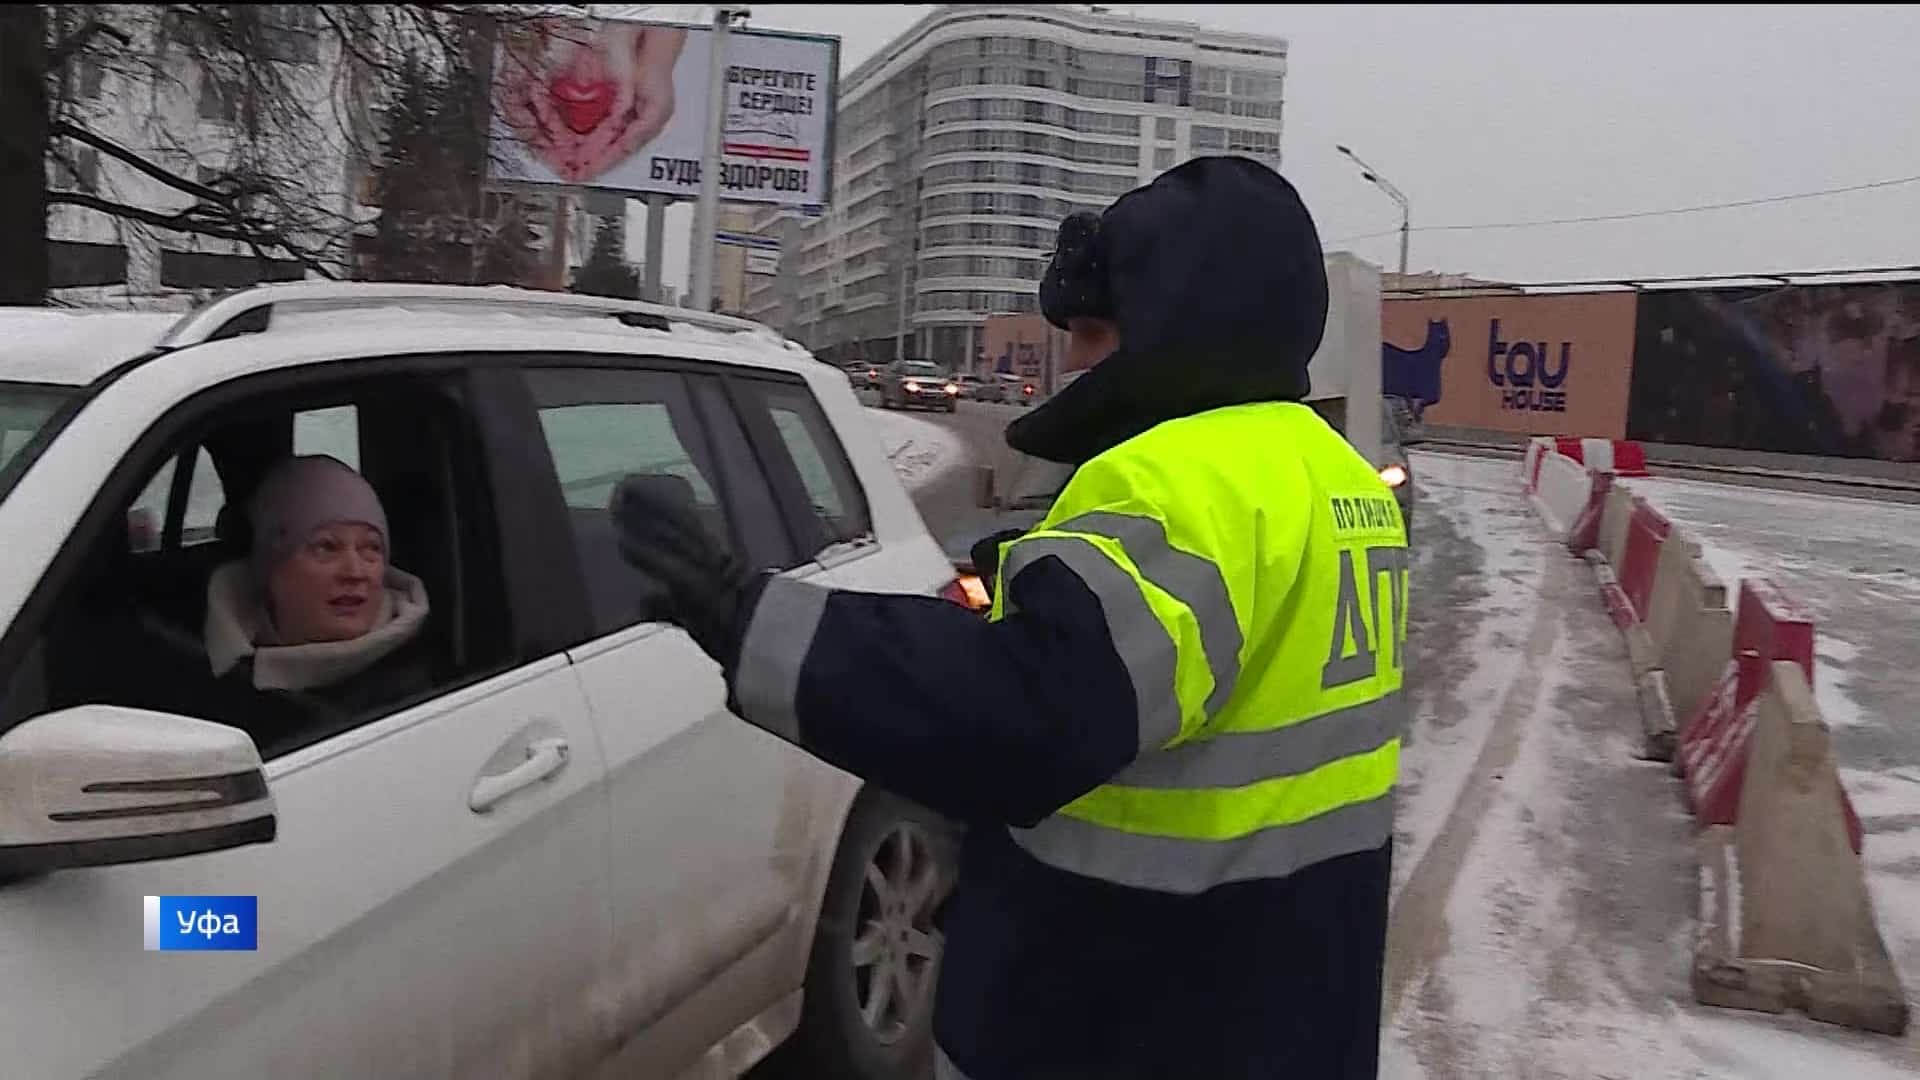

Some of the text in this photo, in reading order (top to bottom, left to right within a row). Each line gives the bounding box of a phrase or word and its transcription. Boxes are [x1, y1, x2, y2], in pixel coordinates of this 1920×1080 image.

[727, 65, 816, 91] БЕРЕГИТЕ
[719, 162, 809, 193] ЗДОРОВ!
[1501, 390, 1566, 412] HOUSE
[1331, 497, 1400, 529] ПОЛИЦИ
[1321, 546, 1408, 689] ДП
